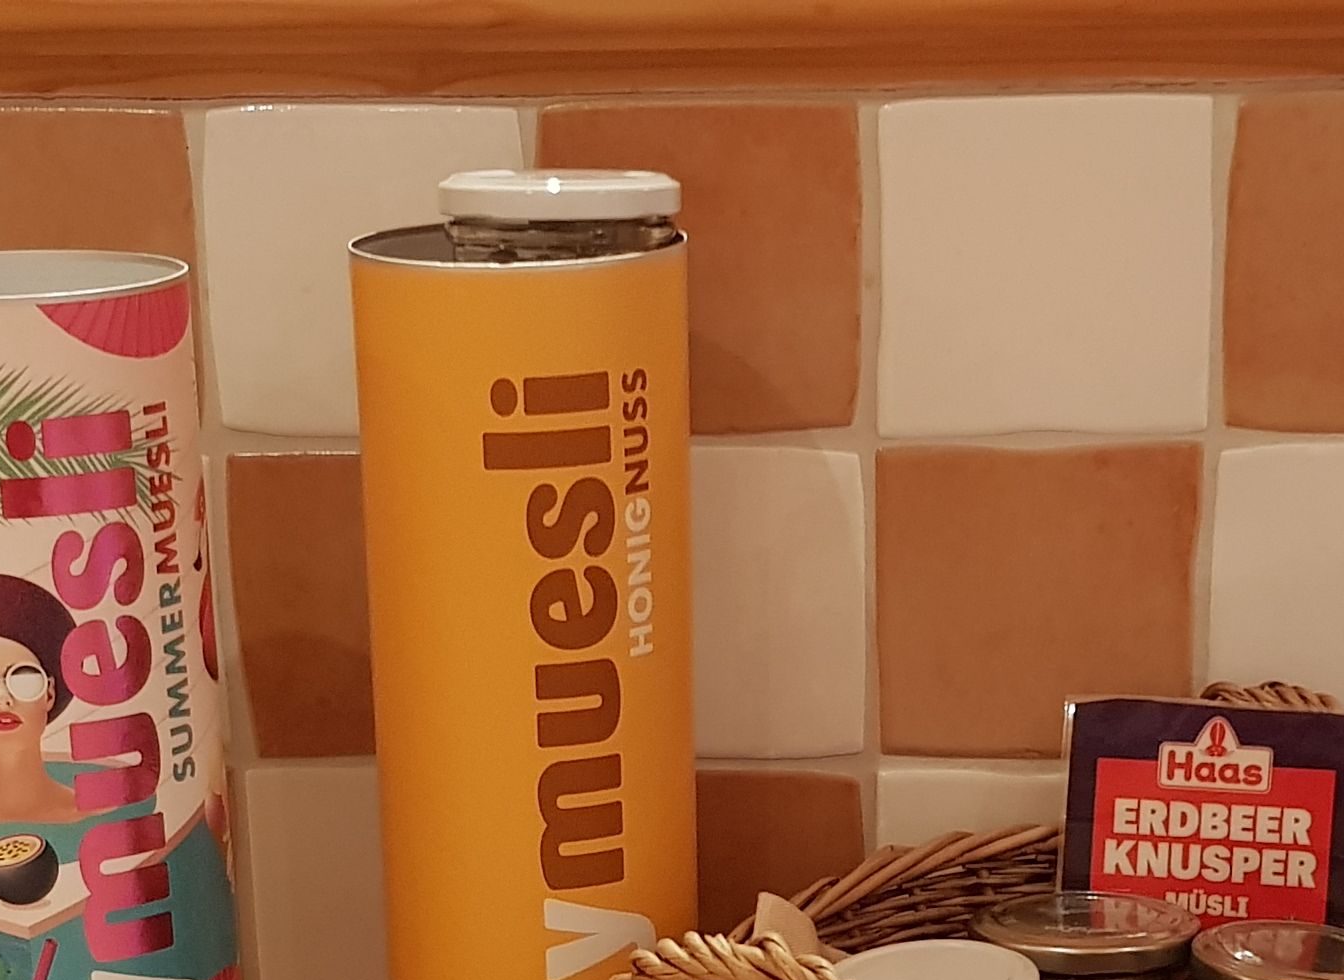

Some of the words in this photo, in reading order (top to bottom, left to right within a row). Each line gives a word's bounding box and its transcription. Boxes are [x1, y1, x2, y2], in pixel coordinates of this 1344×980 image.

[622, 367, 654, 657] HONIGNUSS
[143, 401, 197, 782] SUMMERMUESLI
[1167, 750, 1263, 785] Haas
[1113, 798, 1311, 845] ERDBEER
[1103, 838, 1317, 889] KNUSPER
[1165, 889, 1249, 917] MÜSLI
